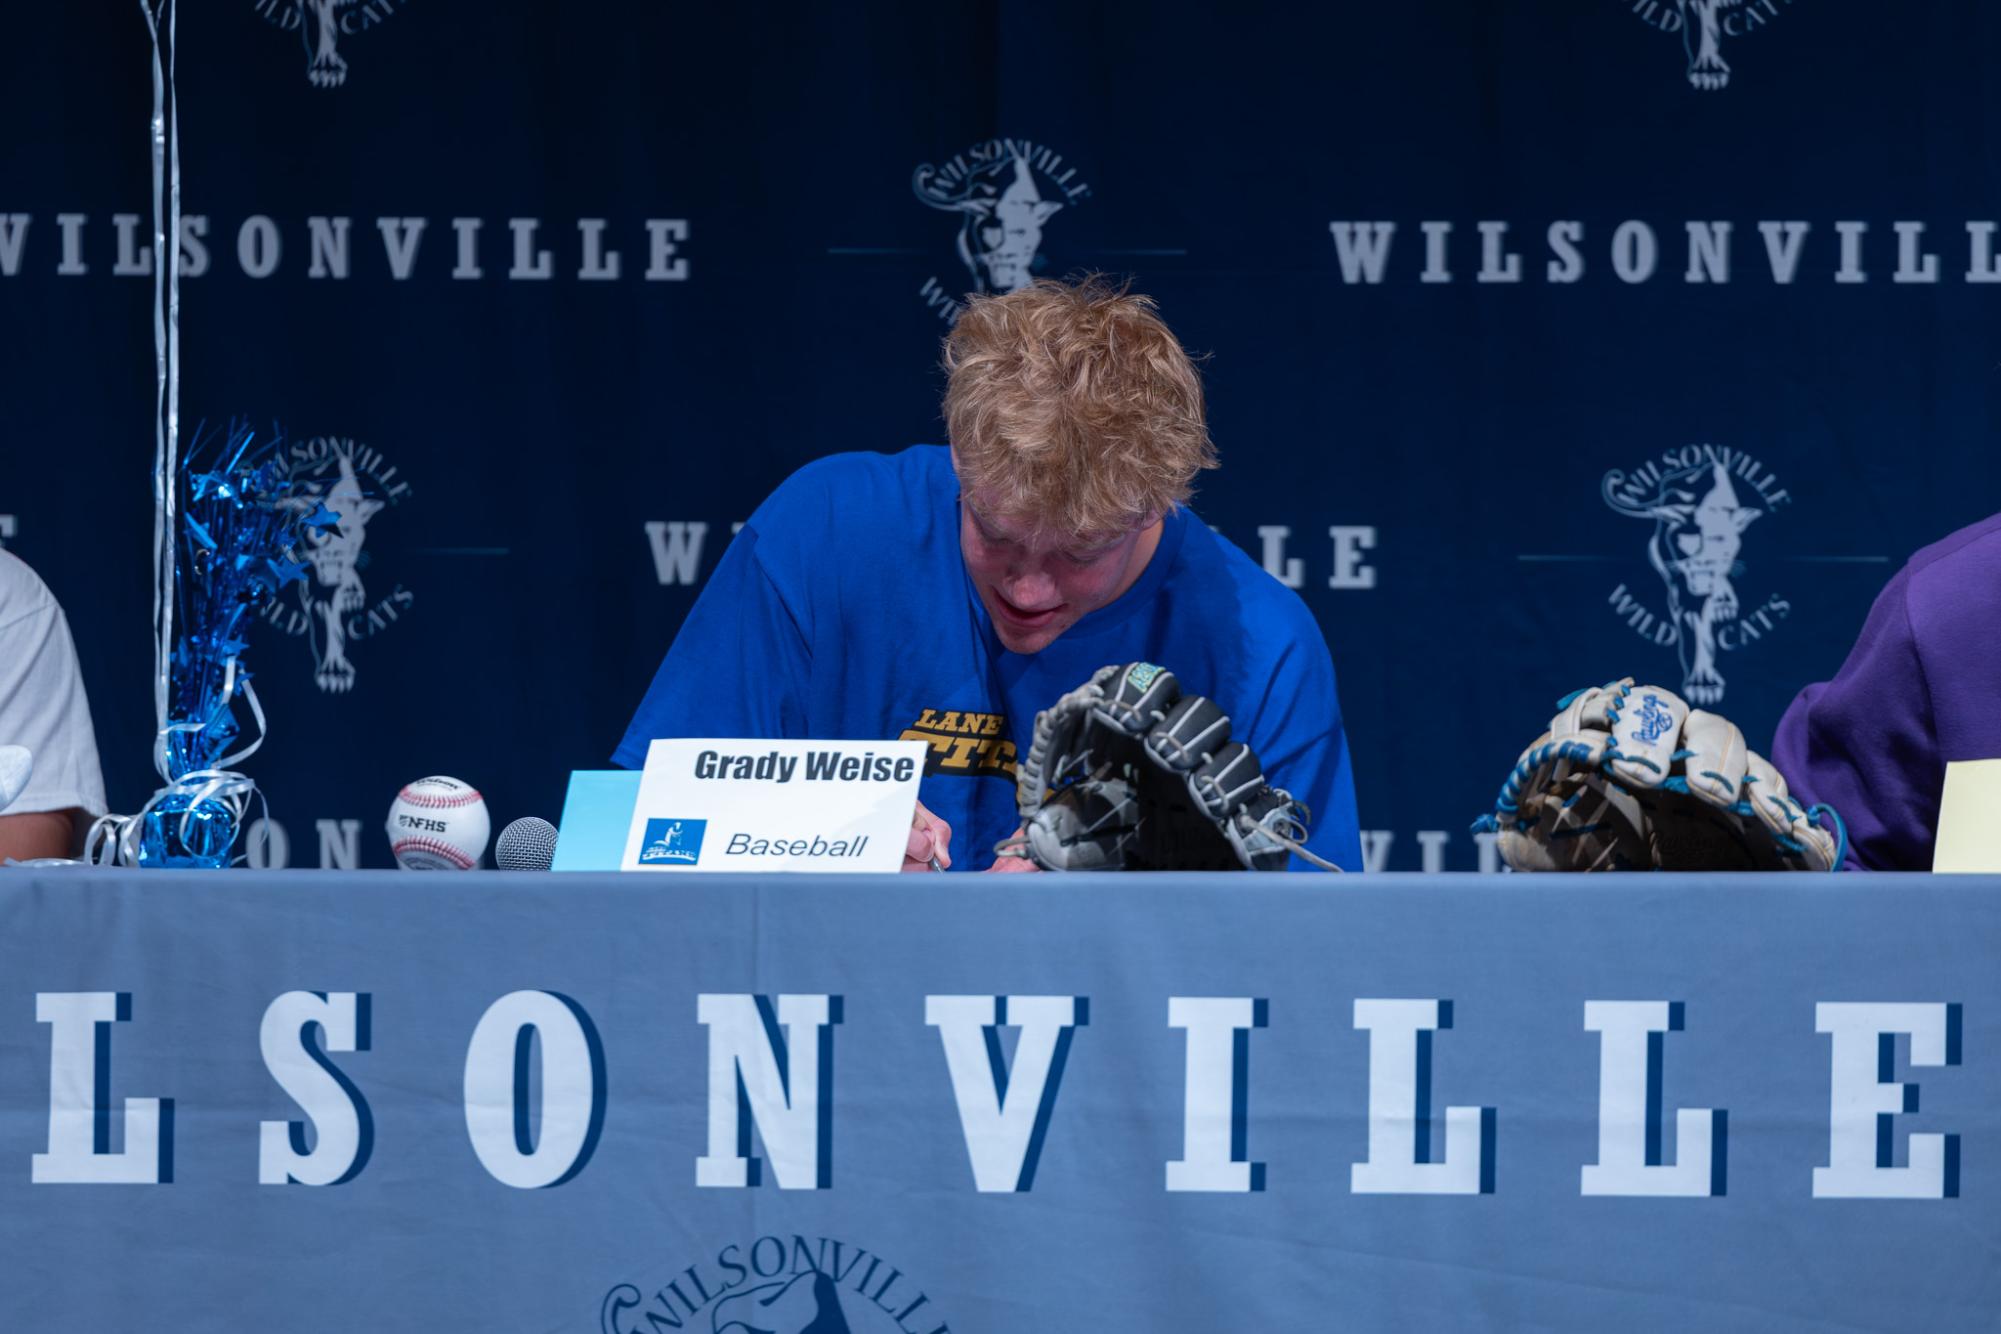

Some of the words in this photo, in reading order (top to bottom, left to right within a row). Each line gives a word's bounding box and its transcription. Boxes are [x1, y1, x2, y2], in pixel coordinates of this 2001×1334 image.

[926, 137, 1094, 207] WILSONVILLE
[1615, 443, 1793, 514] WILSONVILLE
[348, 583, 415, 641] CATS
[1608, 582, 1678, 647] WILD
[1717, 592, 1792, 651] CATS
[914, 708, 1004, 735] LANE
[694, 750, 798, 784] Grady
[805, 751, 915, 782] Weise
[899, 729, 1018, 775] TIT
[408, 816, 447, 833] NFHS
[725, 833, 869, 857] Baseball
